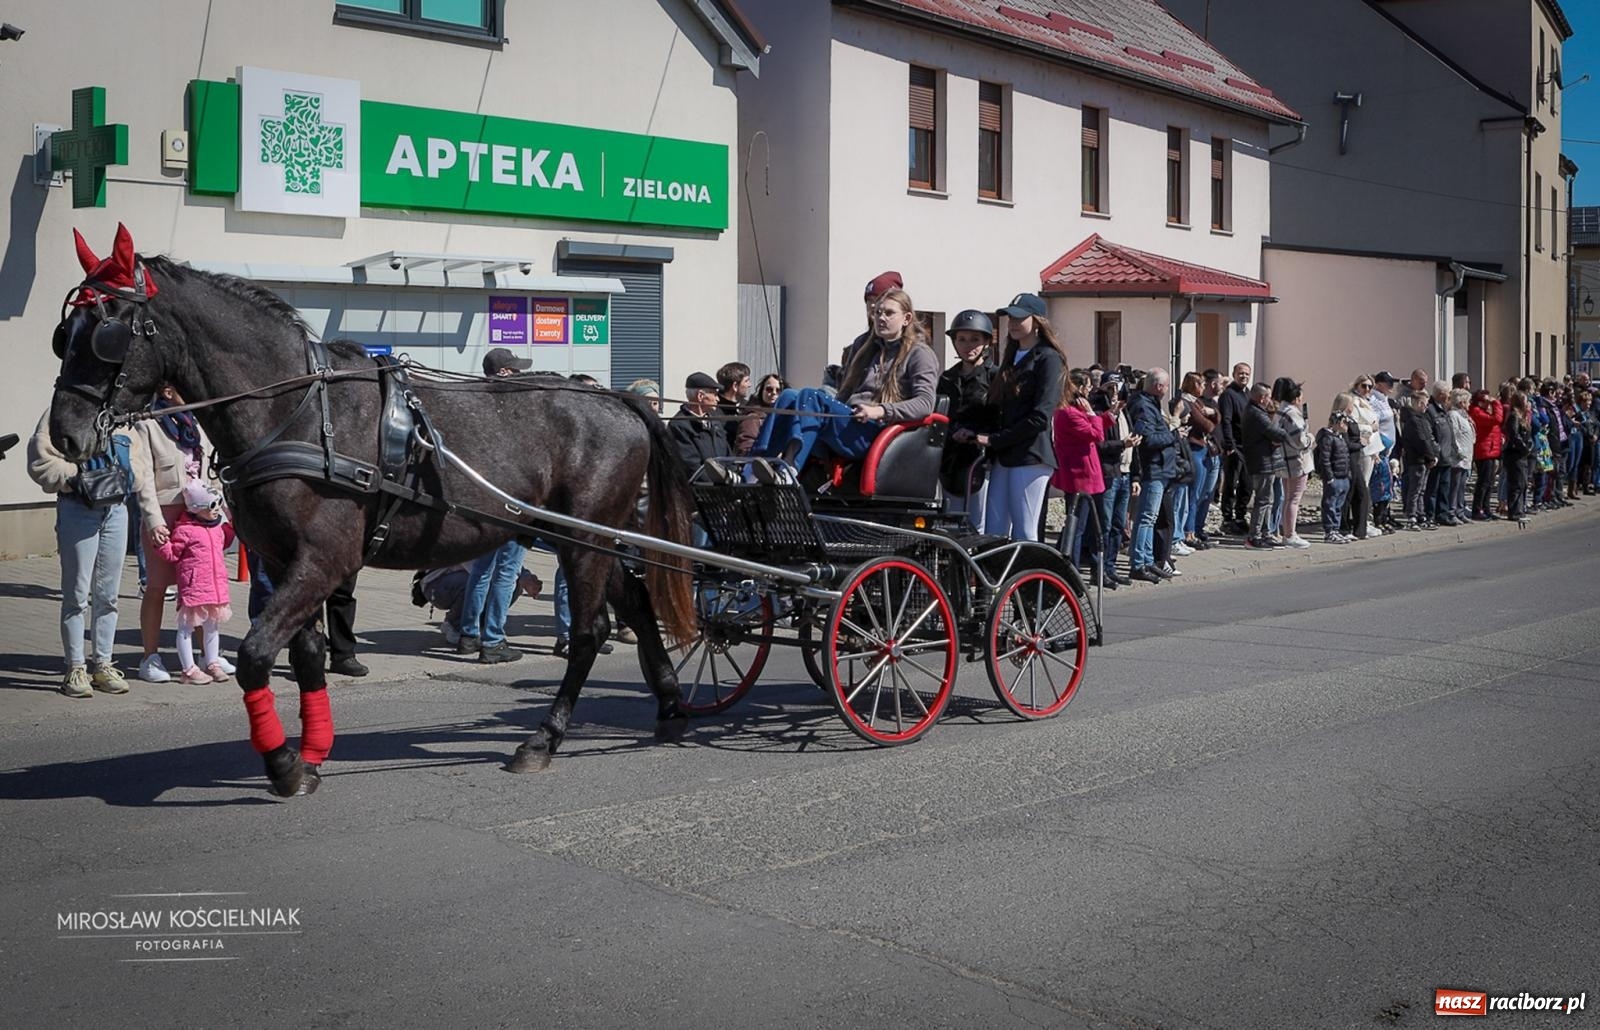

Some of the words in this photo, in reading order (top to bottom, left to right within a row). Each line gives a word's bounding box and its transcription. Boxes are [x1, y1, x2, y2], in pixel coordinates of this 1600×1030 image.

[385, 134, 584, 192] APTEKA
[623, 177, 712, 204] ZIELONA
[535, 304, 565, 313] Darmowe
[535, 316, 561, 326] dostawy
[575, 314, 606, 322] DELIVERY
[539, 329, 561, 339] zwroty
